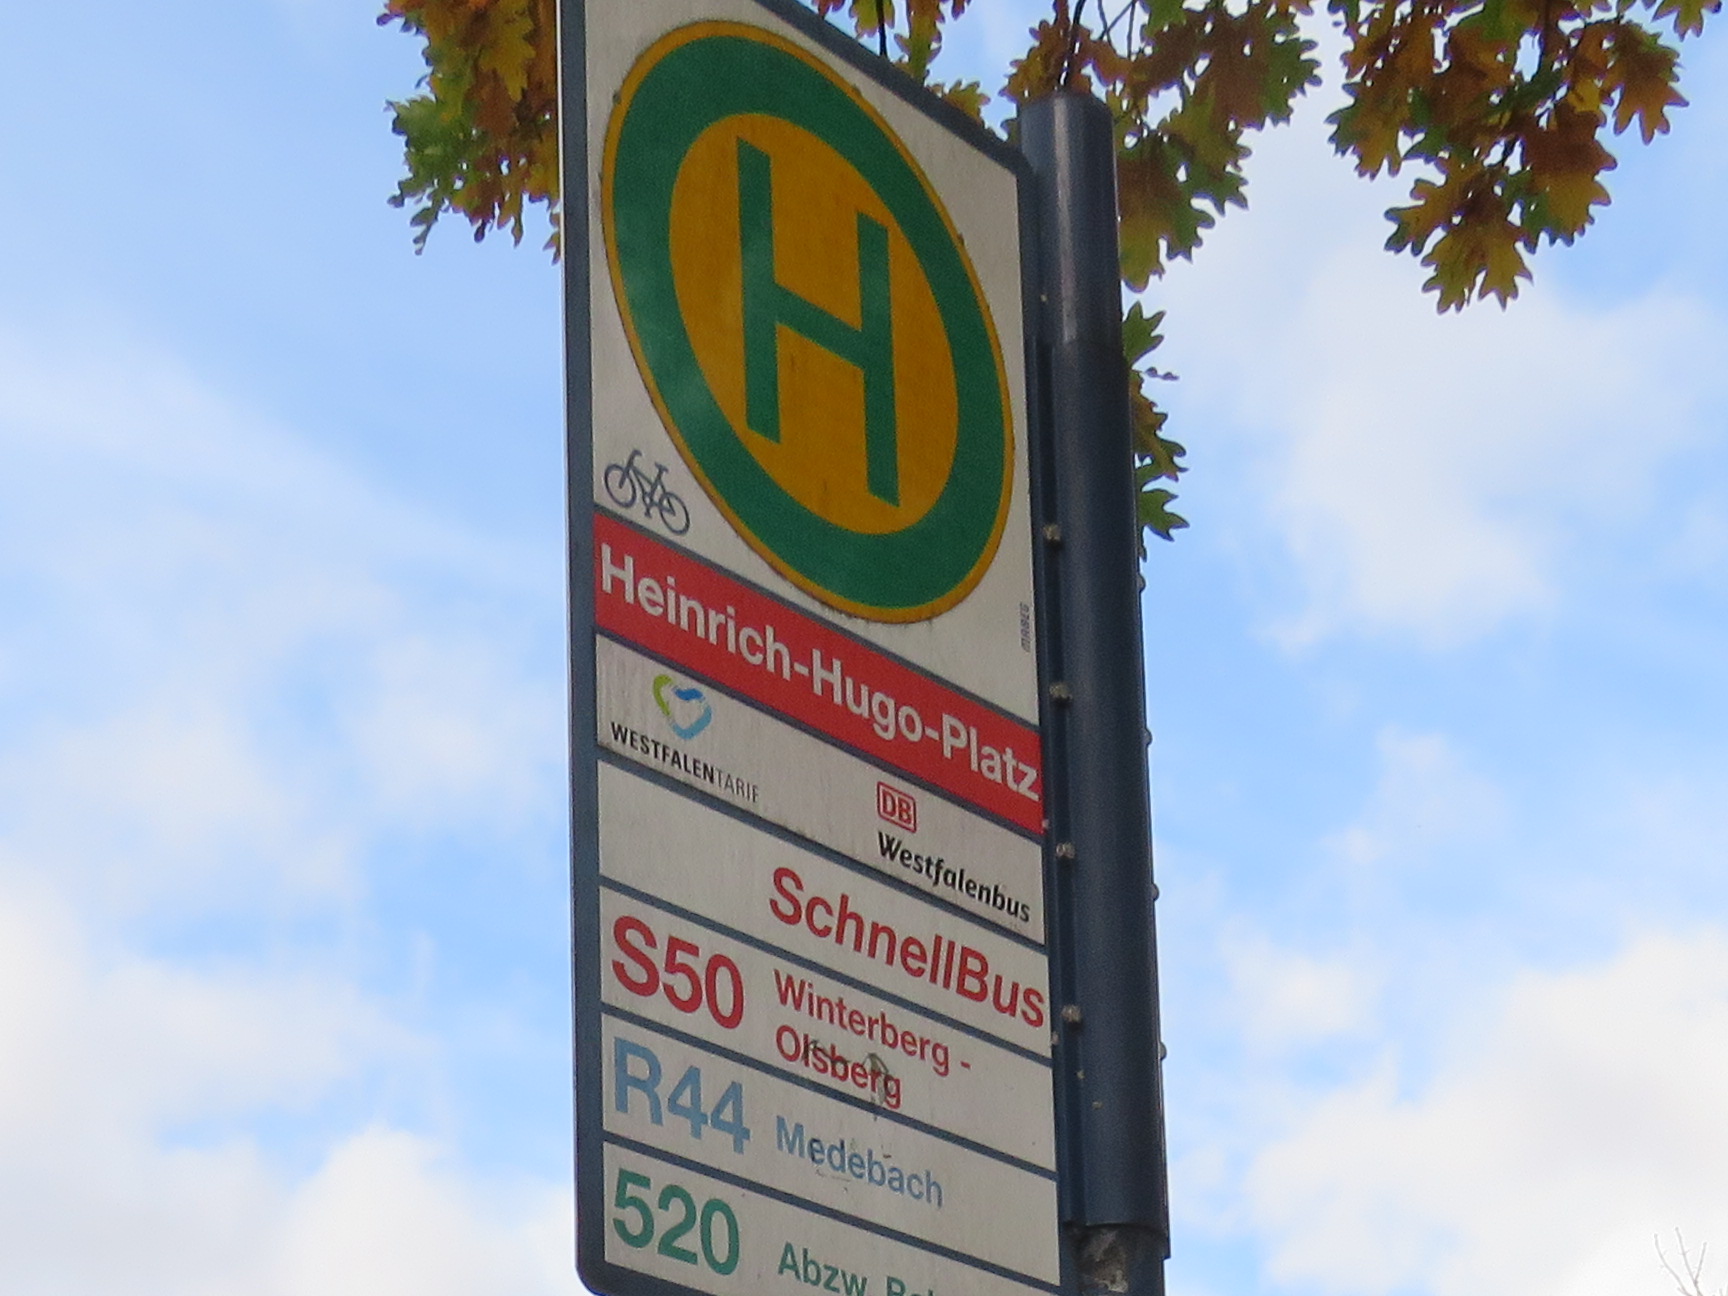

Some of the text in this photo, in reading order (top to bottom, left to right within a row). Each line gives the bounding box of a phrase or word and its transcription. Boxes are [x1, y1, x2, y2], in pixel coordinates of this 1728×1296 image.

[735, 136, 901, 508] H
[600, 542, 1040, 802] Heinrich-Hugo-Platz
[610, 721, 760, 803] WESTFALENTARIF
[882, 788, 913, 825] DB
[877, 830, 1031, 923] Westfalenbus
[611, 914, 745, 1030] S50
[768, 866, 1046, 1028] SchnellBus
[773, 968, 950, 1078] Winterberg
[775, 1024, 902, 1110] Olsberg
[613, 1035, 751, 1156] R44
[775, 1114, 944, 1209] Medebach
[612, 1167, 741, 1277] 520
